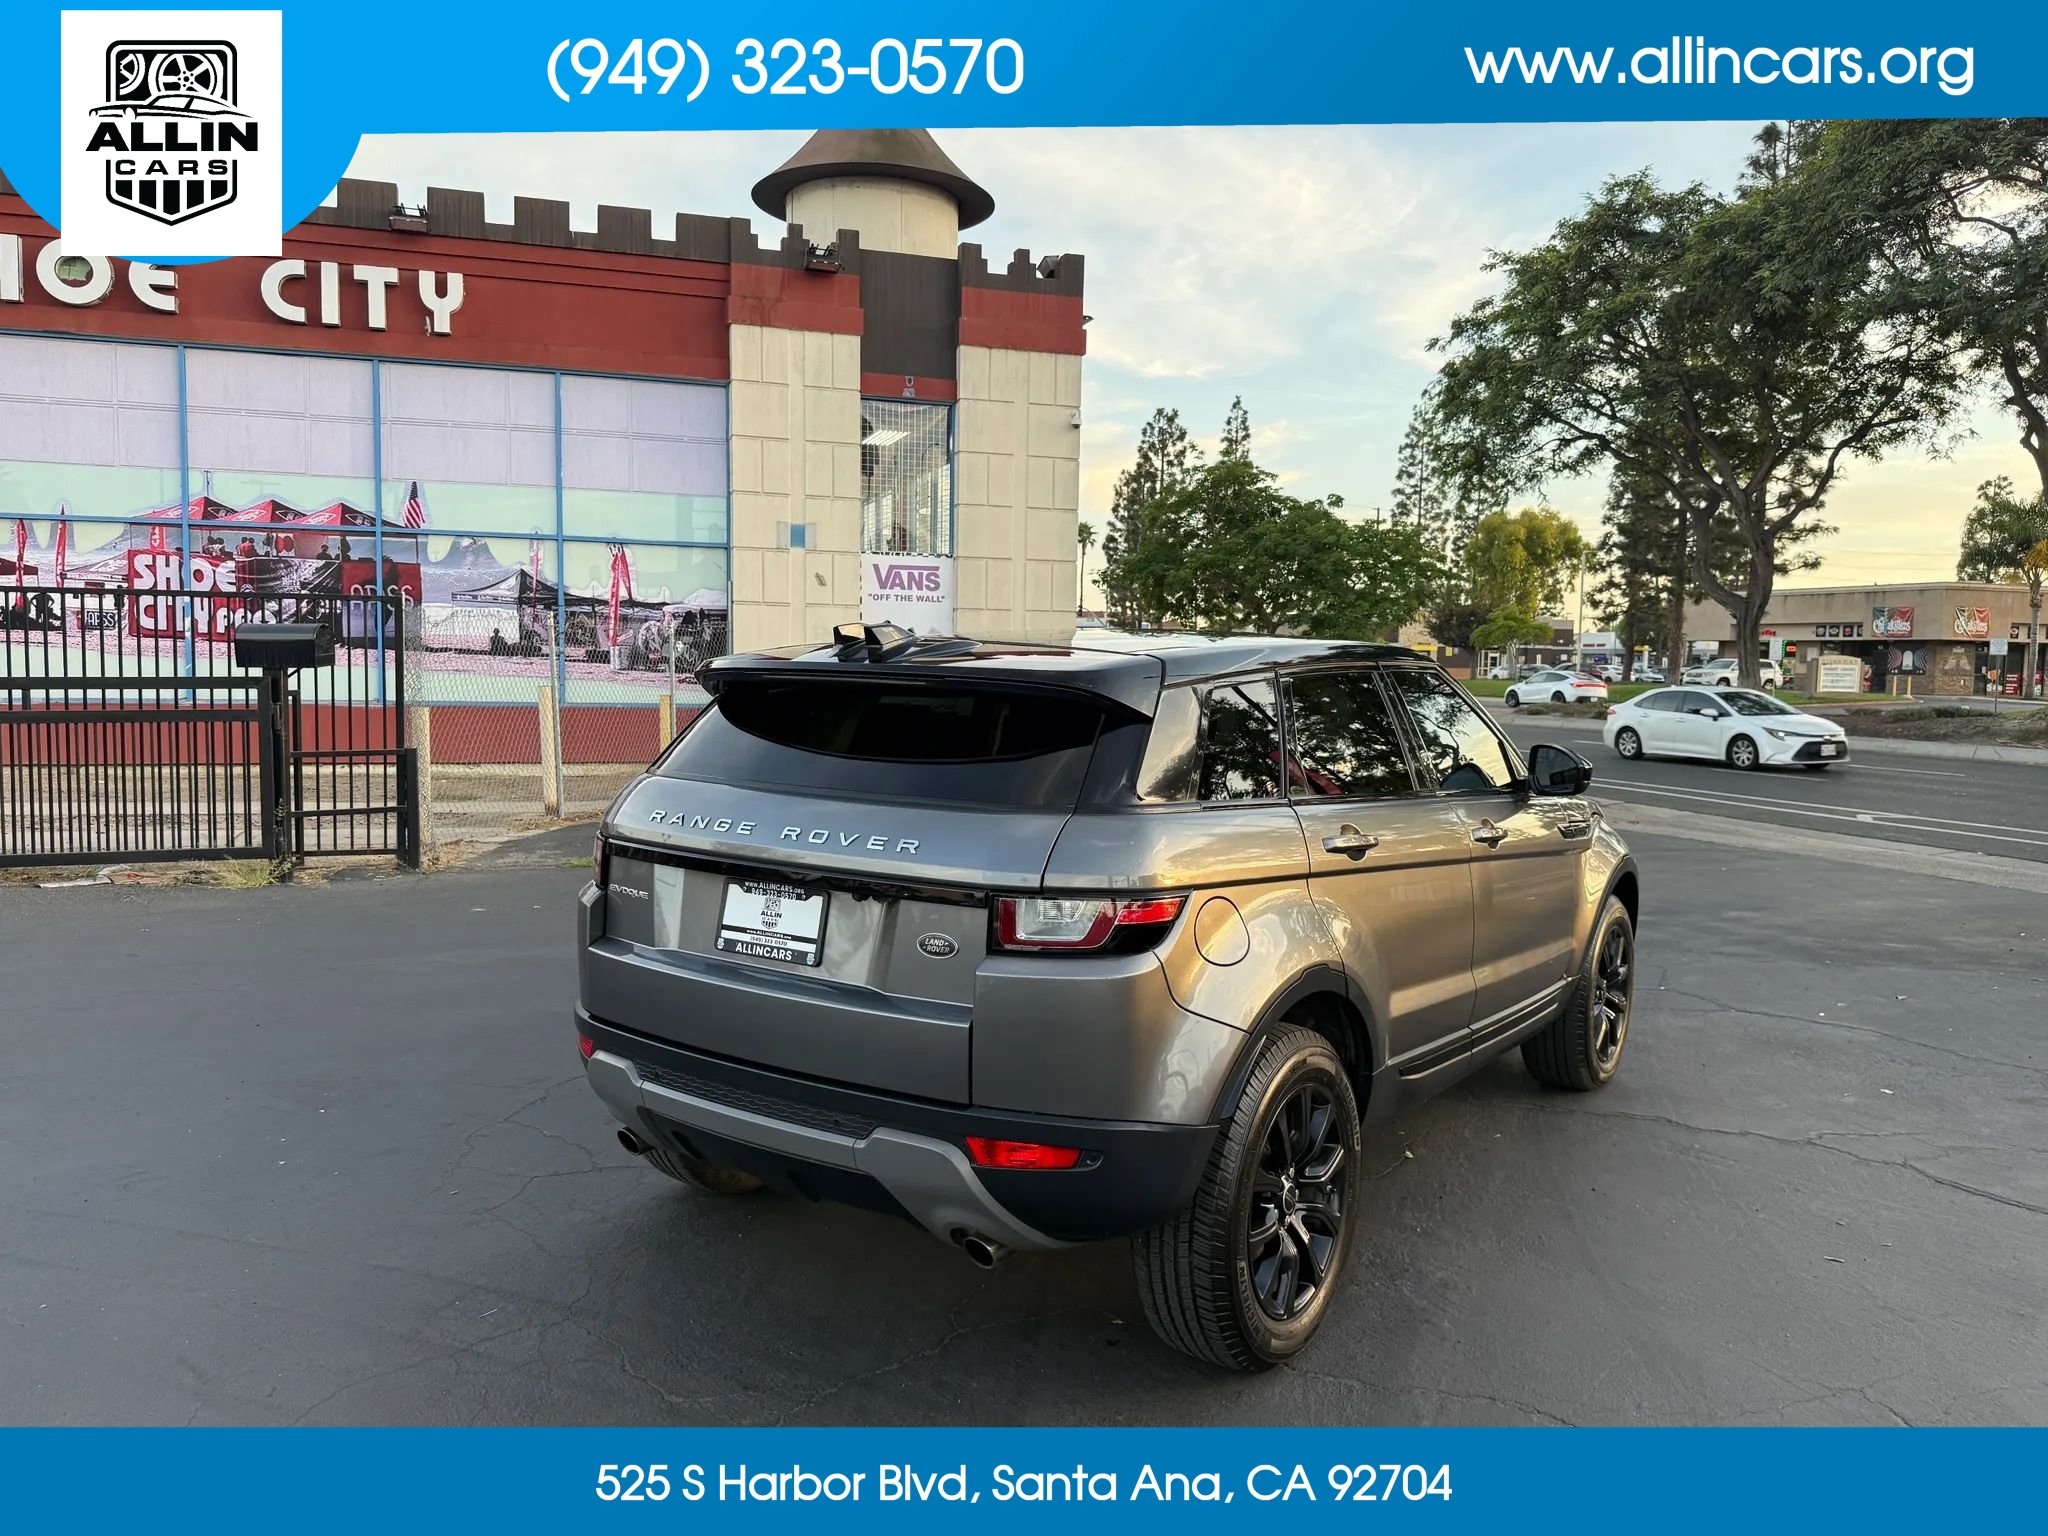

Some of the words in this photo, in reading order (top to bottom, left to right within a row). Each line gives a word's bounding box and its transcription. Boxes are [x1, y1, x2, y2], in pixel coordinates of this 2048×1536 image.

[261, 259, 464, 336] CITY
[872, 563, 941, 592] VANS
[868, 593, 891, 601] "OFF
[894, 594, 914, 602] THE
[916, 595, 946, 603] WALL"
[648, 809, 757, 836] RANGE
[780, 826, 921, 855] ROVER
[610, 883, 649, 900] EVOQUE
[925, 938, 944, 946] LAND
[926, 945, 950, 953] ROVER
[735, 942, 792, 961] ALLINCARS
